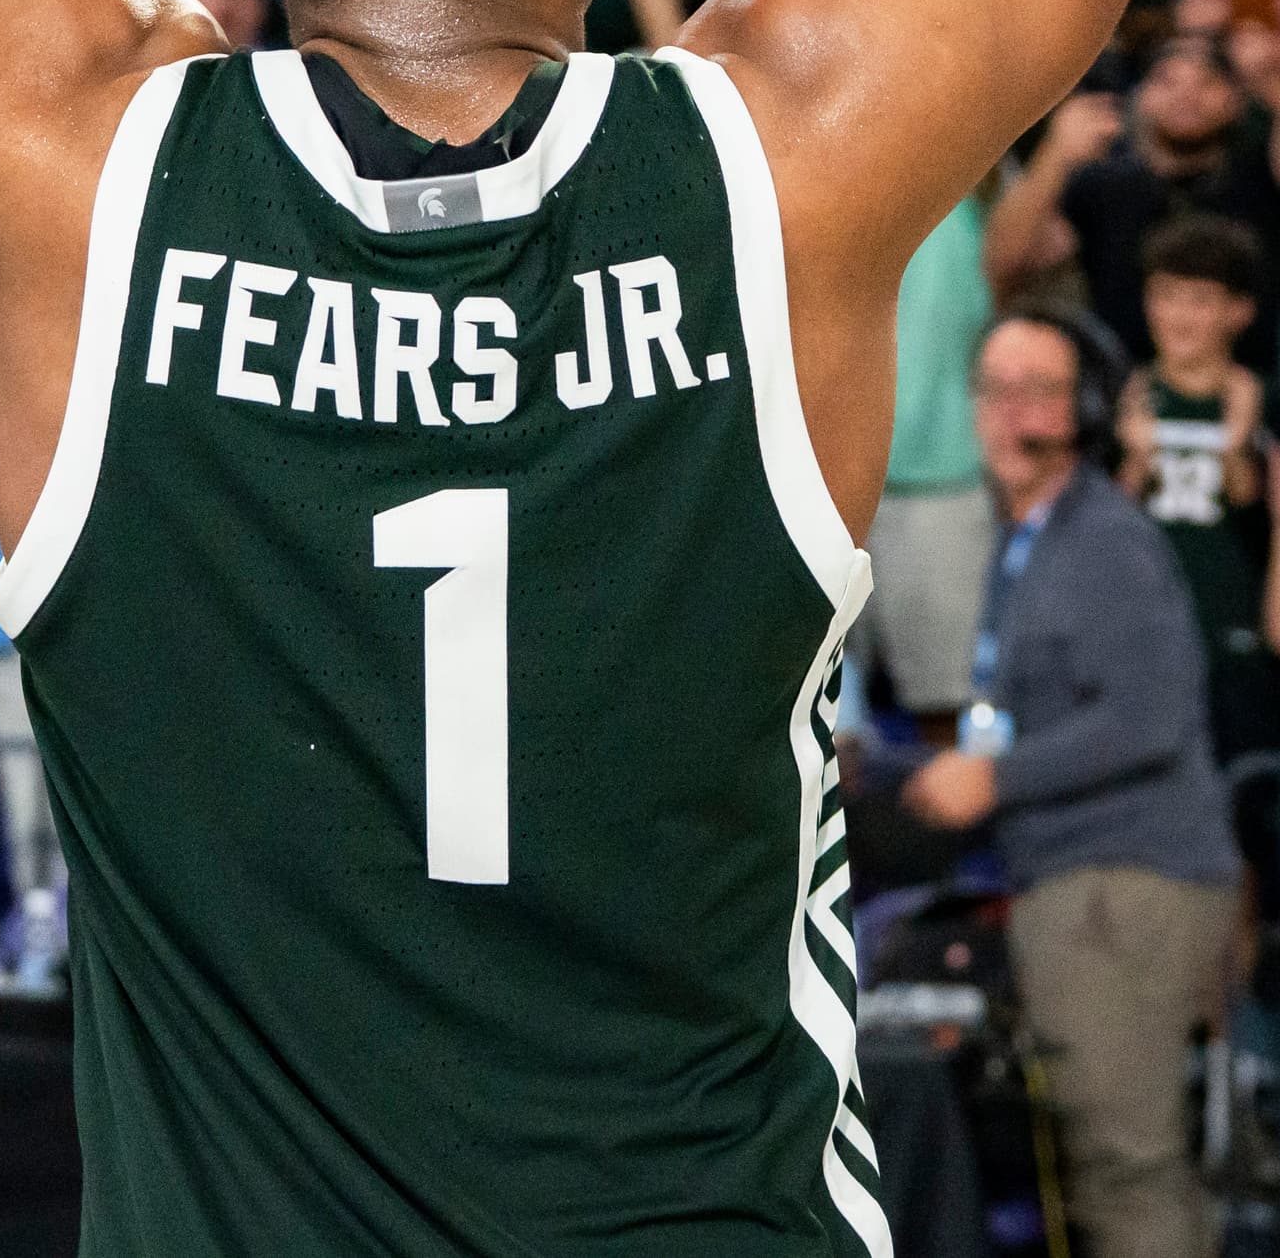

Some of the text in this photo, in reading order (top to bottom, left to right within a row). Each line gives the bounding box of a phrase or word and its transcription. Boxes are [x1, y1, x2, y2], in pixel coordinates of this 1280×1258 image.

[145, 248, 730, 427] FEARS JR.
[373, 488, 509, 885] 1
